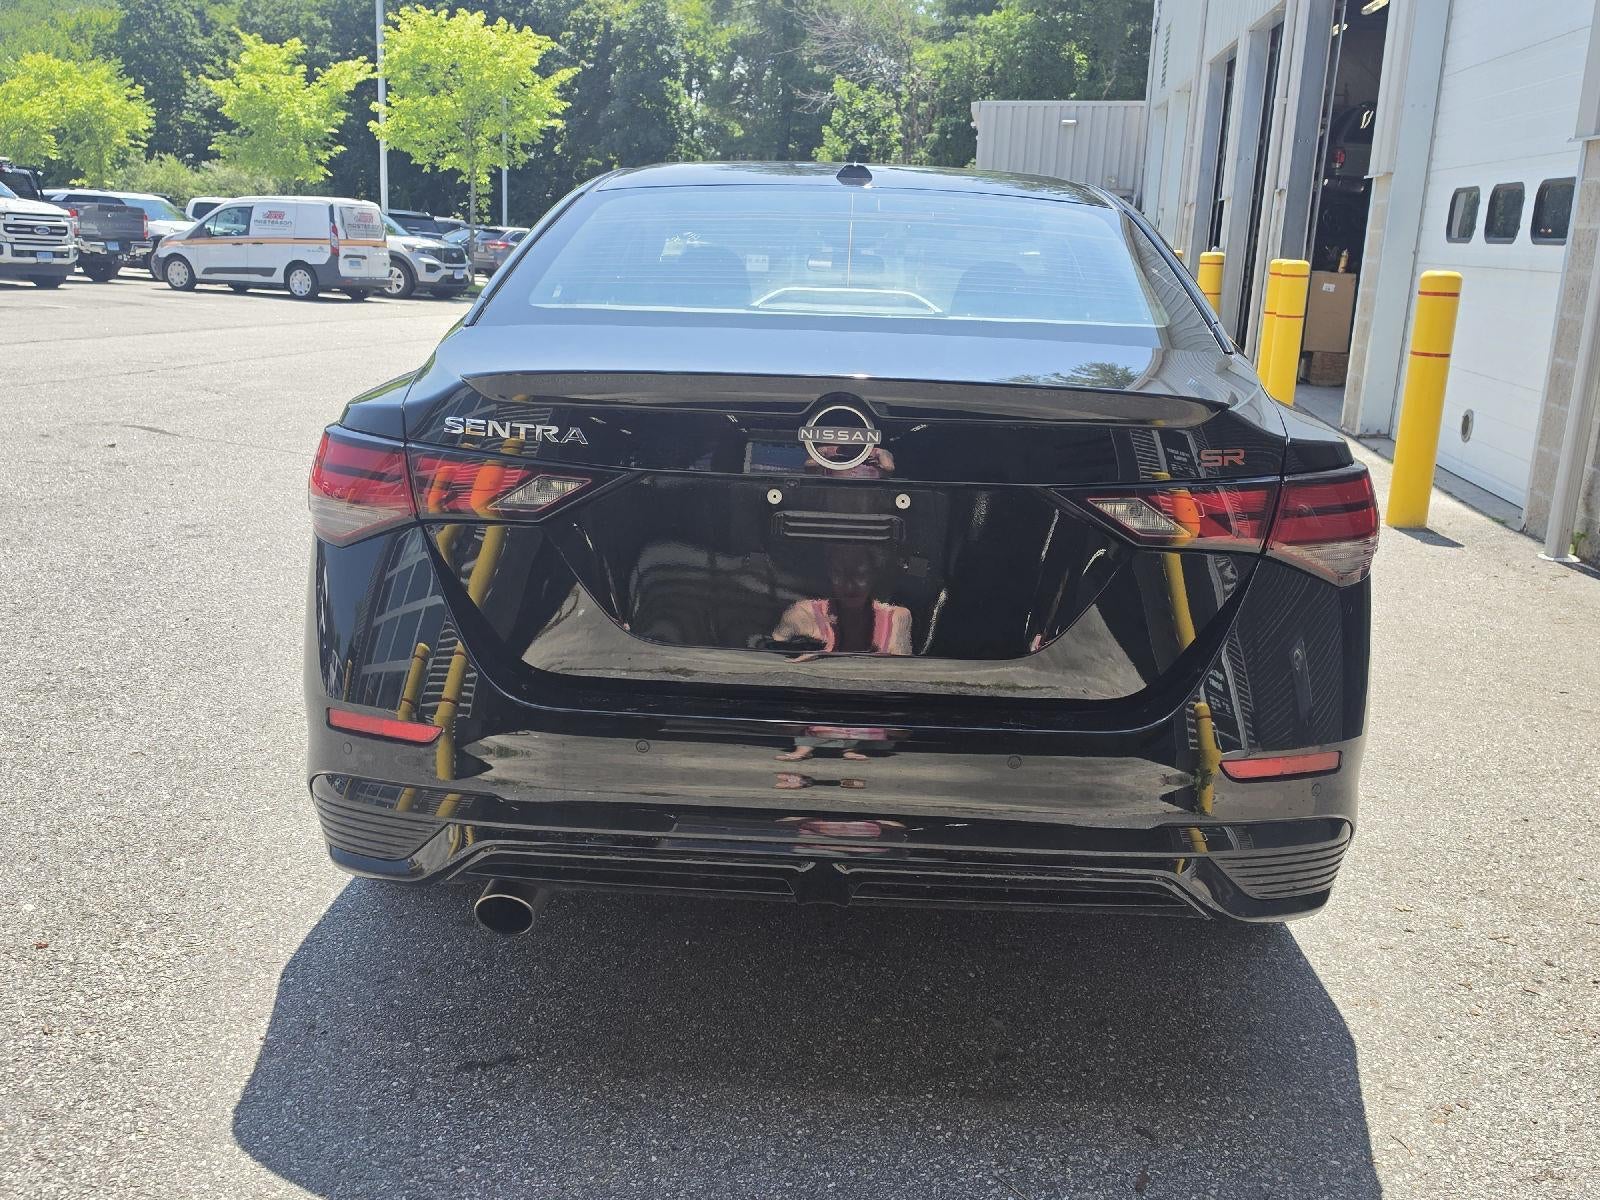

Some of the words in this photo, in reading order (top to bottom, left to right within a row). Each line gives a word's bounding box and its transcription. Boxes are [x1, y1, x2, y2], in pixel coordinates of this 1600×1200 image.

[444, 416, 588, 445] SENTRA
[801, 429, 879, 442] NISSAN
[1200, 448, 1245, 467] SR
